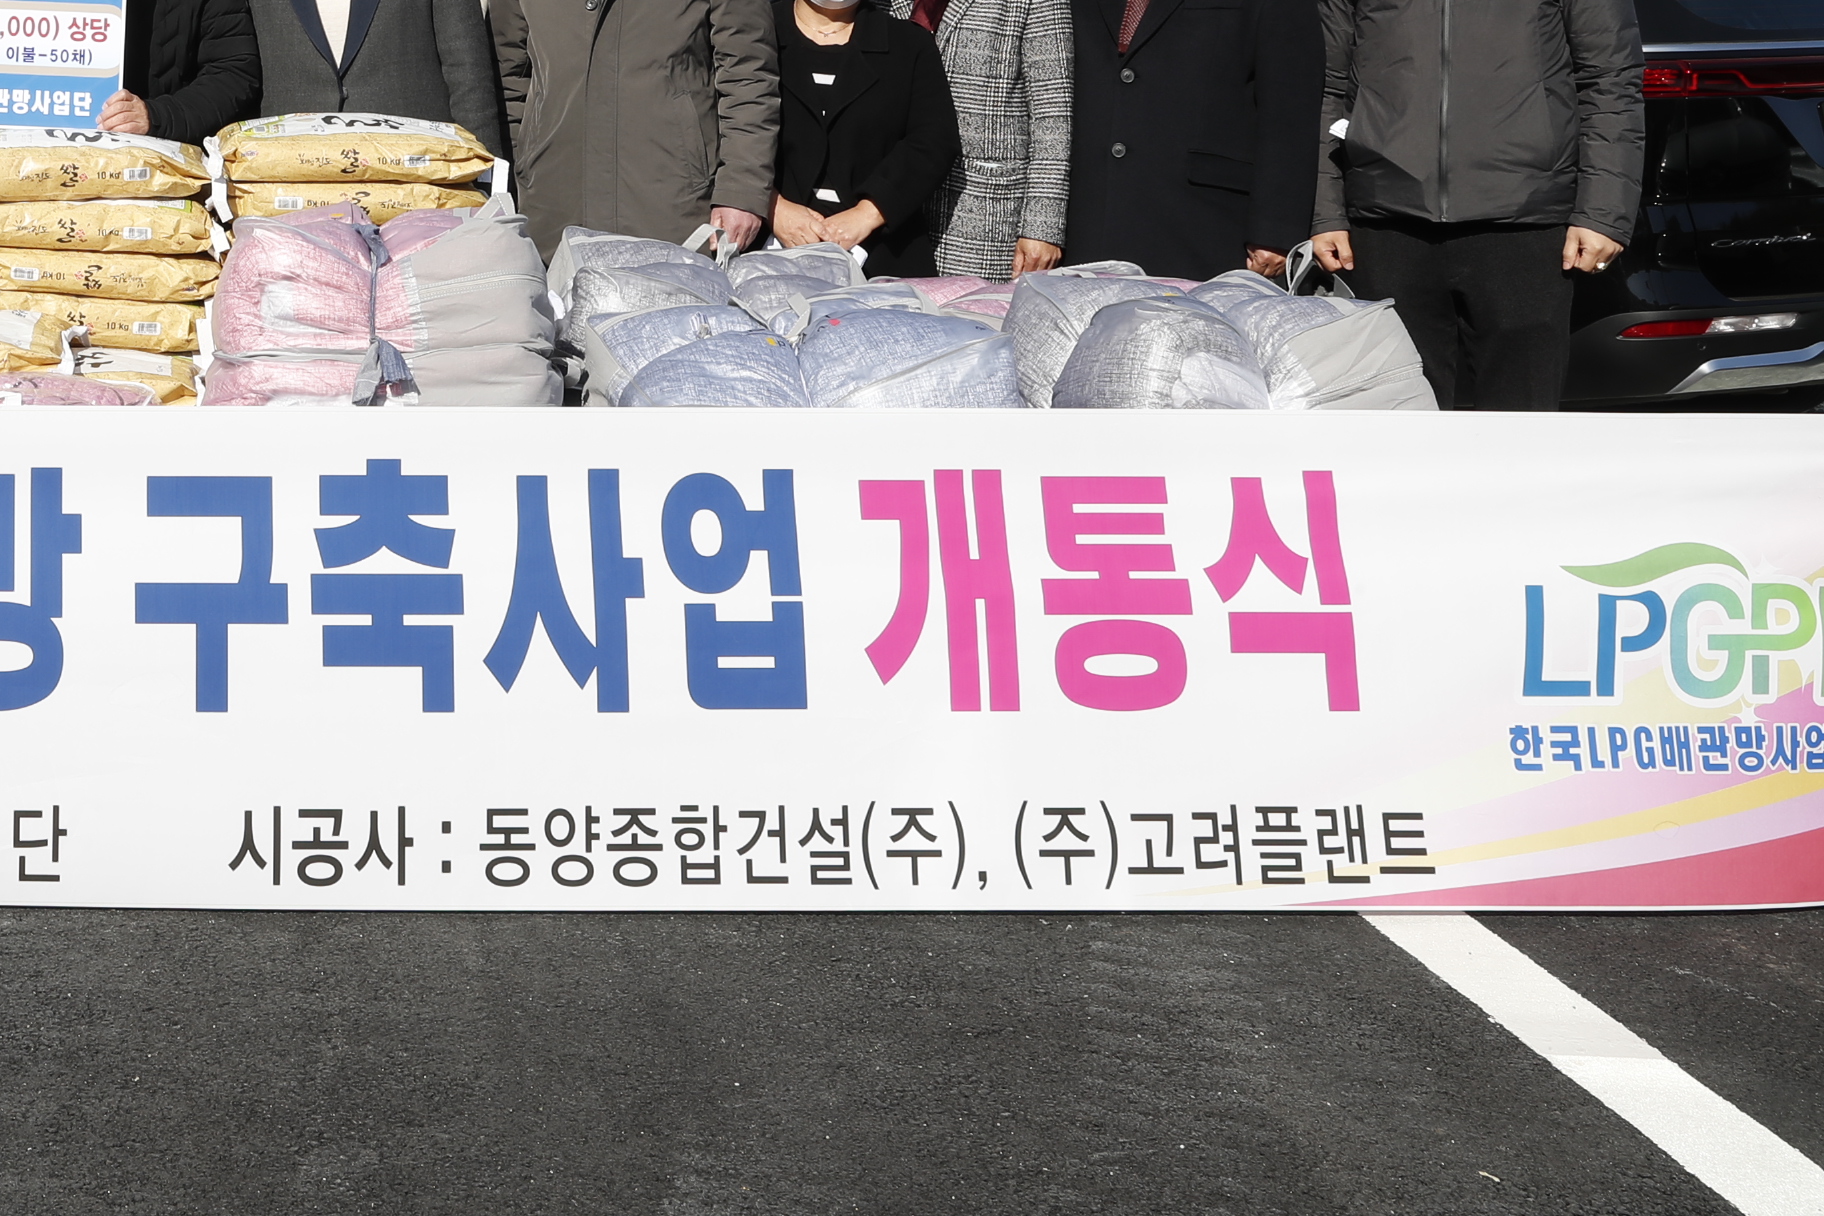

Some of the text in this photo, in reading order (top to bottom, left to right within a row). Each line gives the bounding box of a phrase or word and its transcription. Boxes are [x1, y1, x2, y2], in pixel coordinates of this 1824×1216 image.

[6, 46, 93, 66] 이불-50채)
[68, 17, 110, 42] 상당
[106, 321, 116, 330] 10
[134, 458, 808, 712] 구축사업
[858, 469, 1361, 712] 개통식
[1522, 582, 1824, 699] LPGP
[228, 805, 414, 887] 시공사
[478, 800, 988, 890] 동양종합건설(주),
[1014, 800, 1437, 890] (주)고려플랜트
